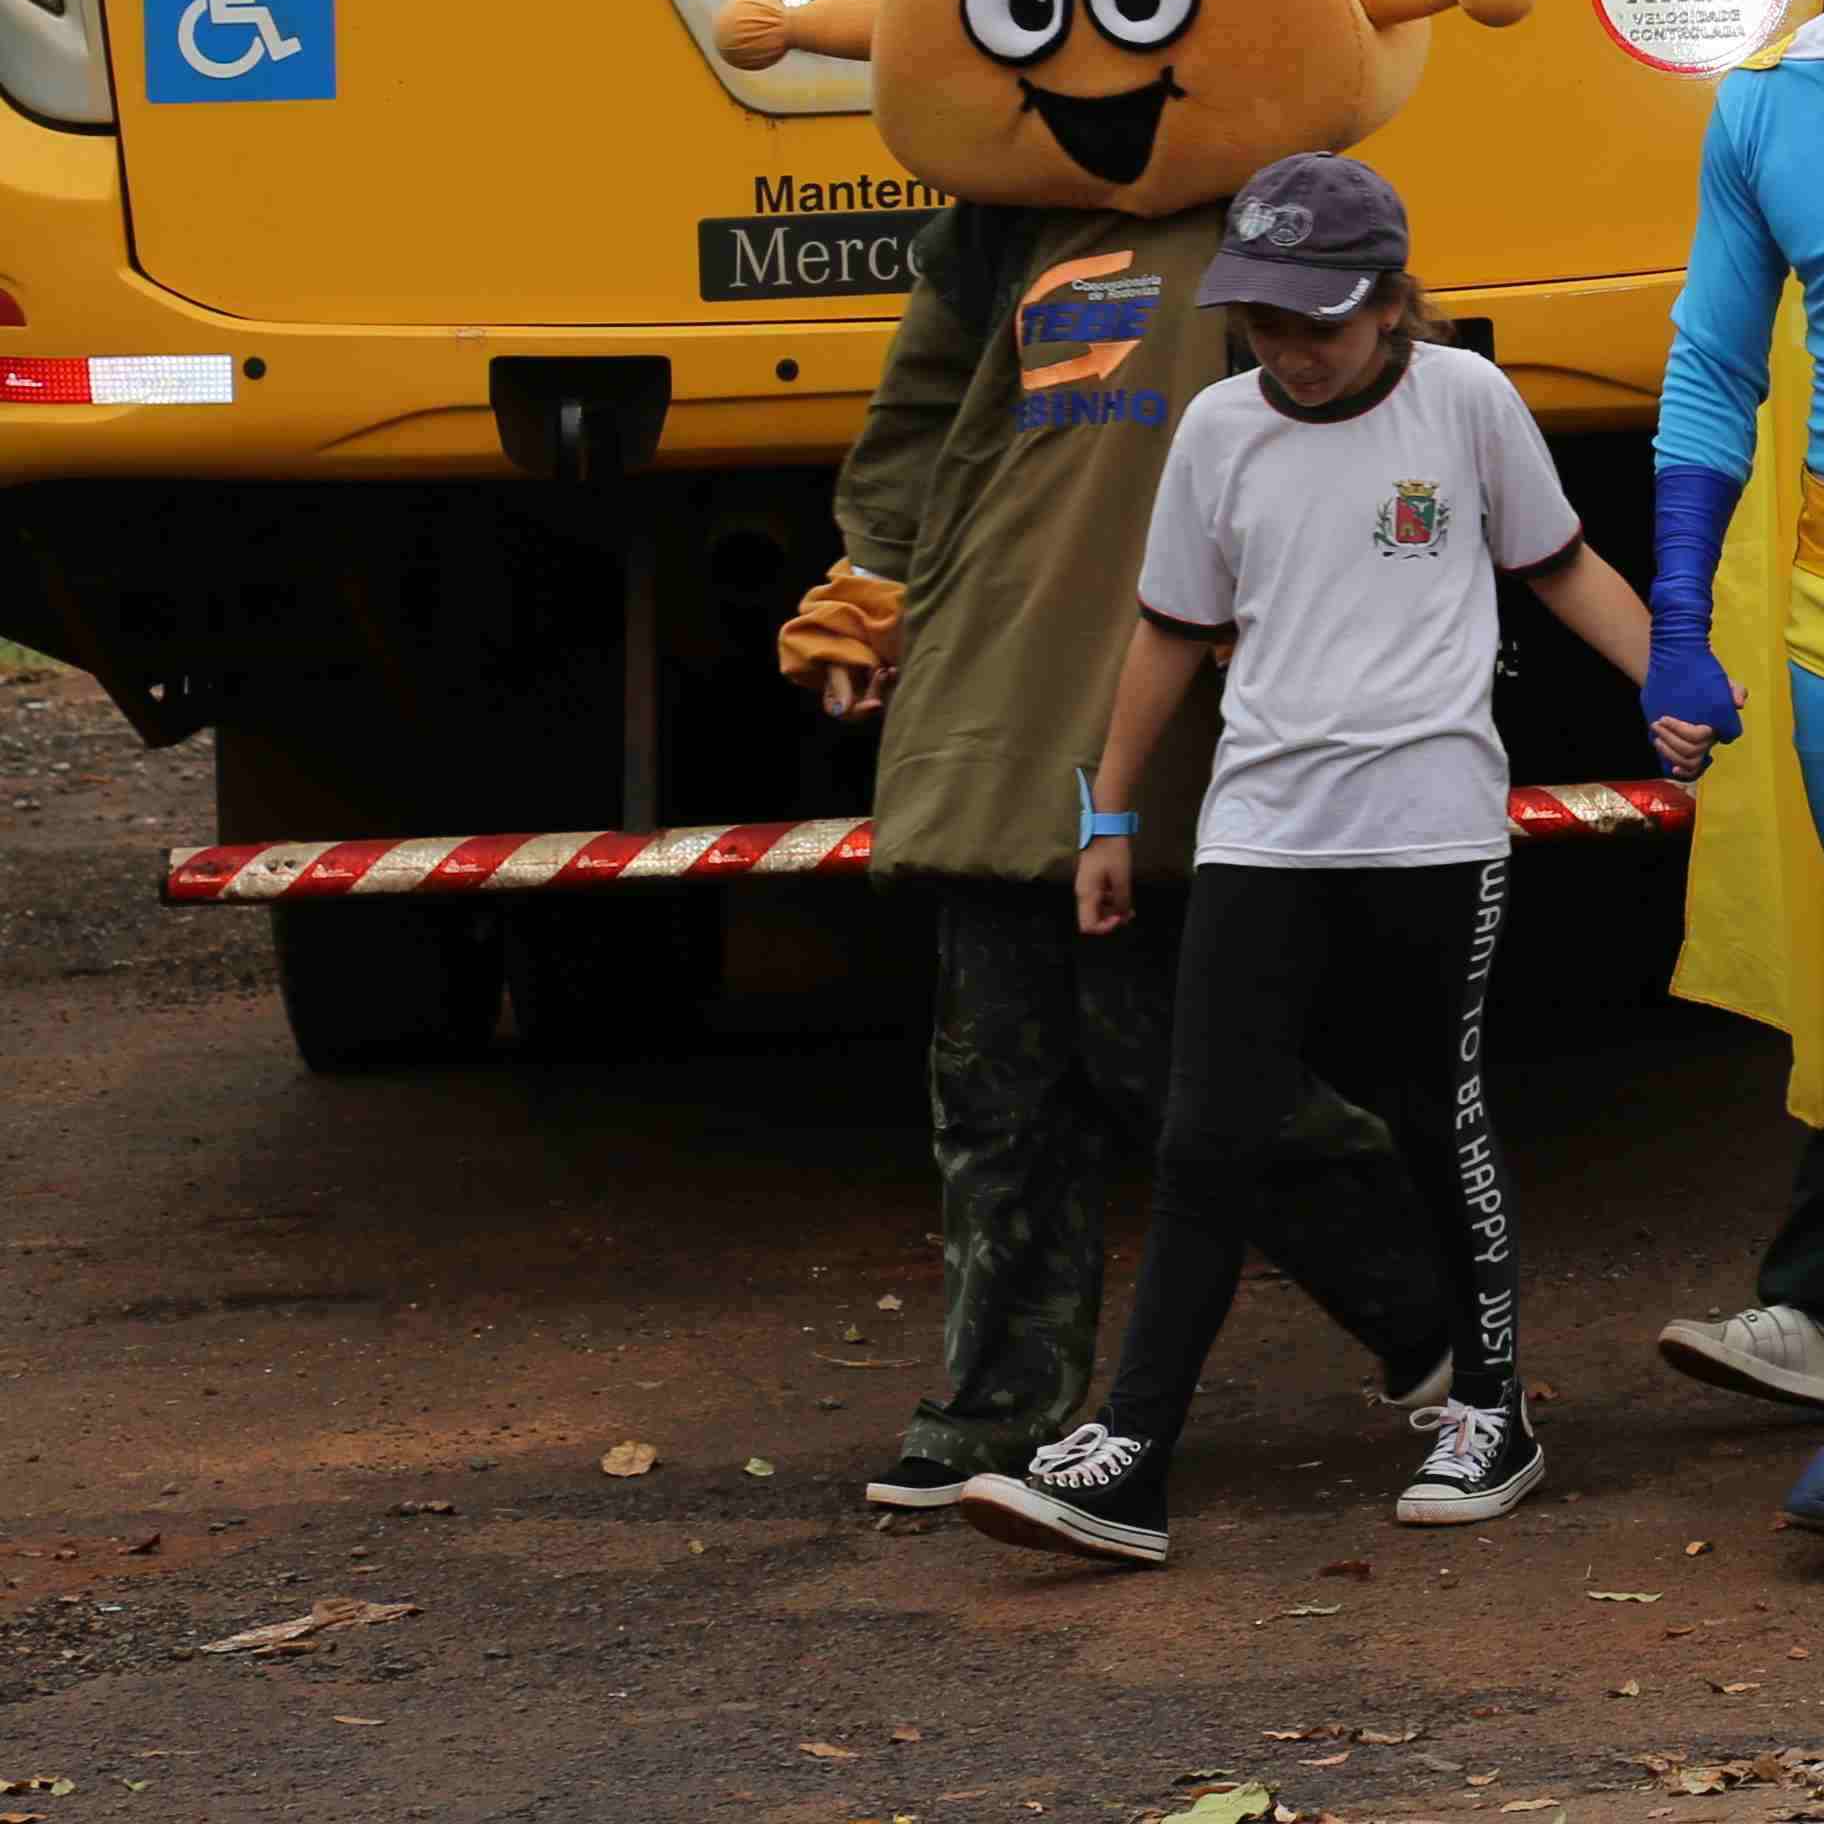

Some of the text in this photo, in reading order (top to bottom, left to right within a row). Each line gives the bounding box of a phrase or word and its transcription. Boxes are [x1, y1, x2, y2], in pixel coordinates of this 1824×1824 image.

[1631, 8, 1742, 25] VELOCIDADE
[755, 174, 948, 214] Manten
[1467, 860, 1505, 981] WANT
[1460, 995, 1484, 1062] TO
[1455, 1073, 1484, 1130] BE
[1458, 1134, 1510, 1263] HAPPY
[1479, 1288, 1513, 1366] JUST
